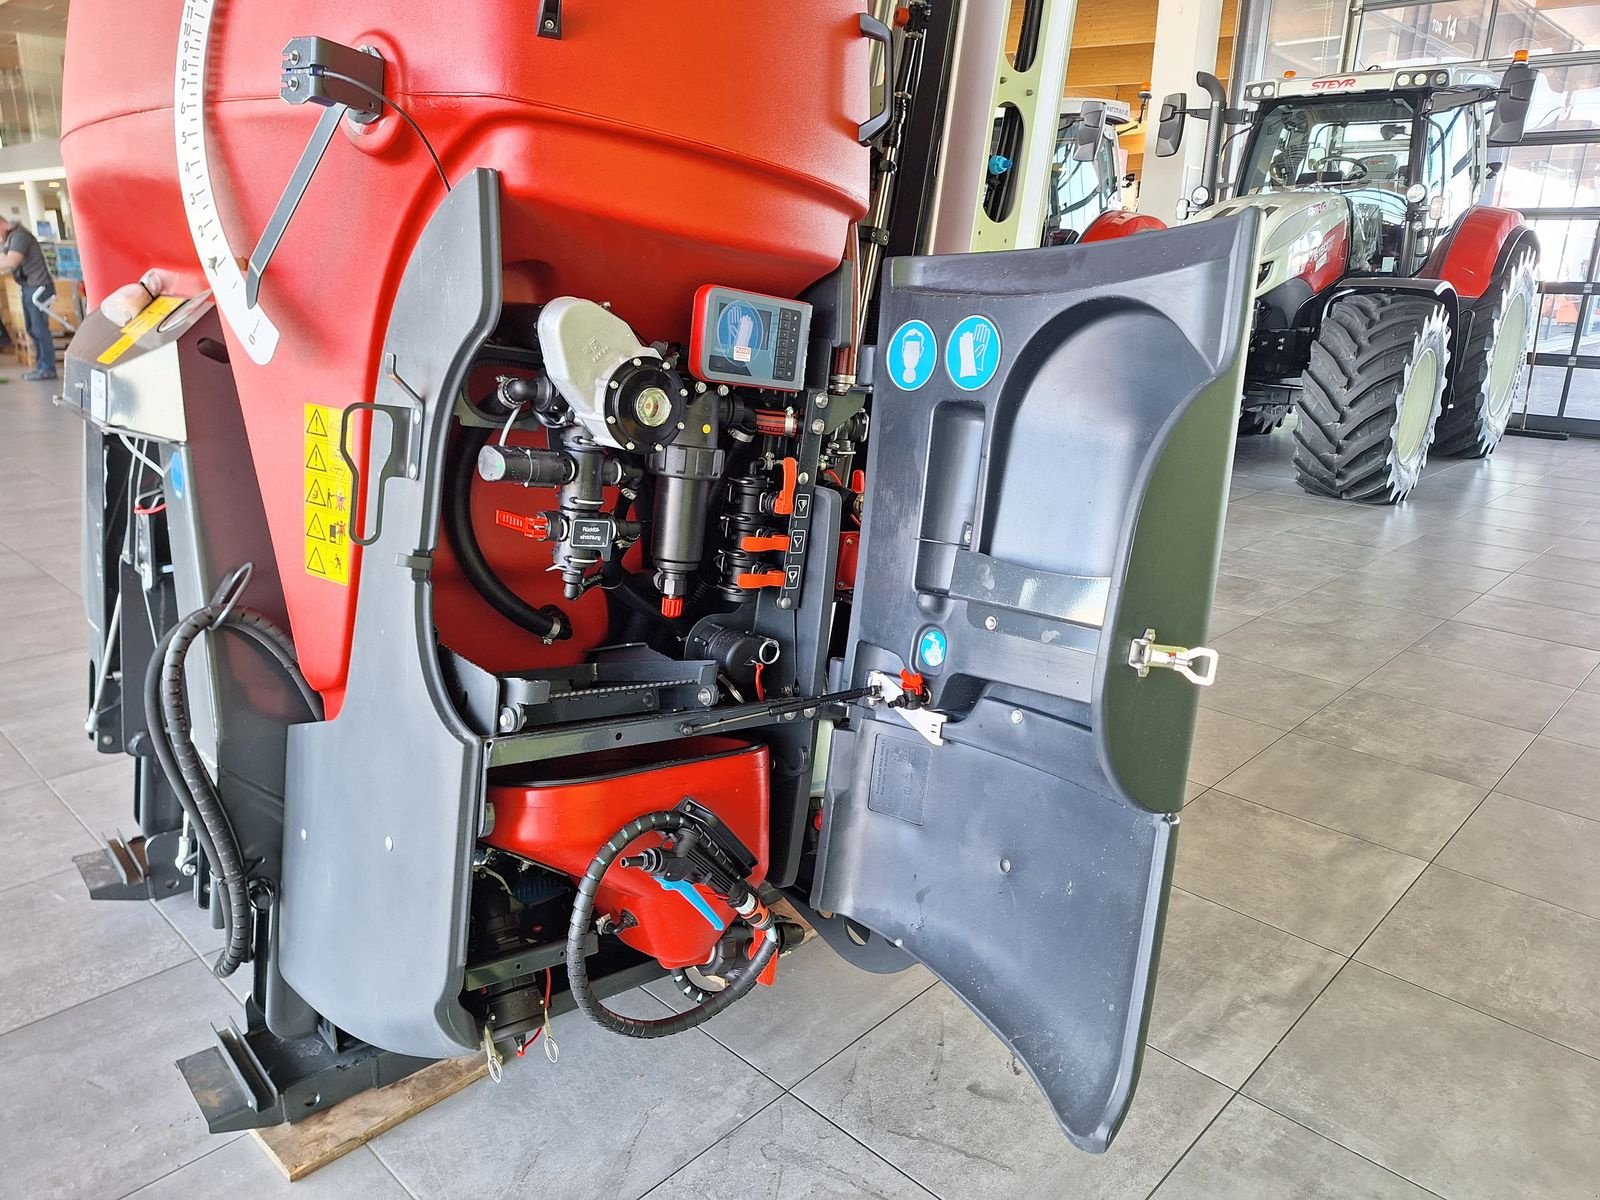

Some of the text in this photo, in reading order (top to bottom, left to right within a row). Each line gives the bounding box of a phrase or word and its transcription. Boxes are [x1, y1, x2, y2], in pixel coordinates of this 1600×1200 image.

[187, 5, 194, 19] 11
[183, 23, 191, 36] 10
[1445, 14, 1458, 42] 14
[184, 41, 190, 53] 9
[182, 59, 187, 72] 8
[181, 78, 186, 90] 7
[1311, 78, 1356, 90] STEYR
[180, 102, 186, 114] 6
[181, 131, 187, 144] 5
[185, 161, 191, 174] 4
[190, 192, 196, 205] 3
[198, 225, 204, 237] 2
